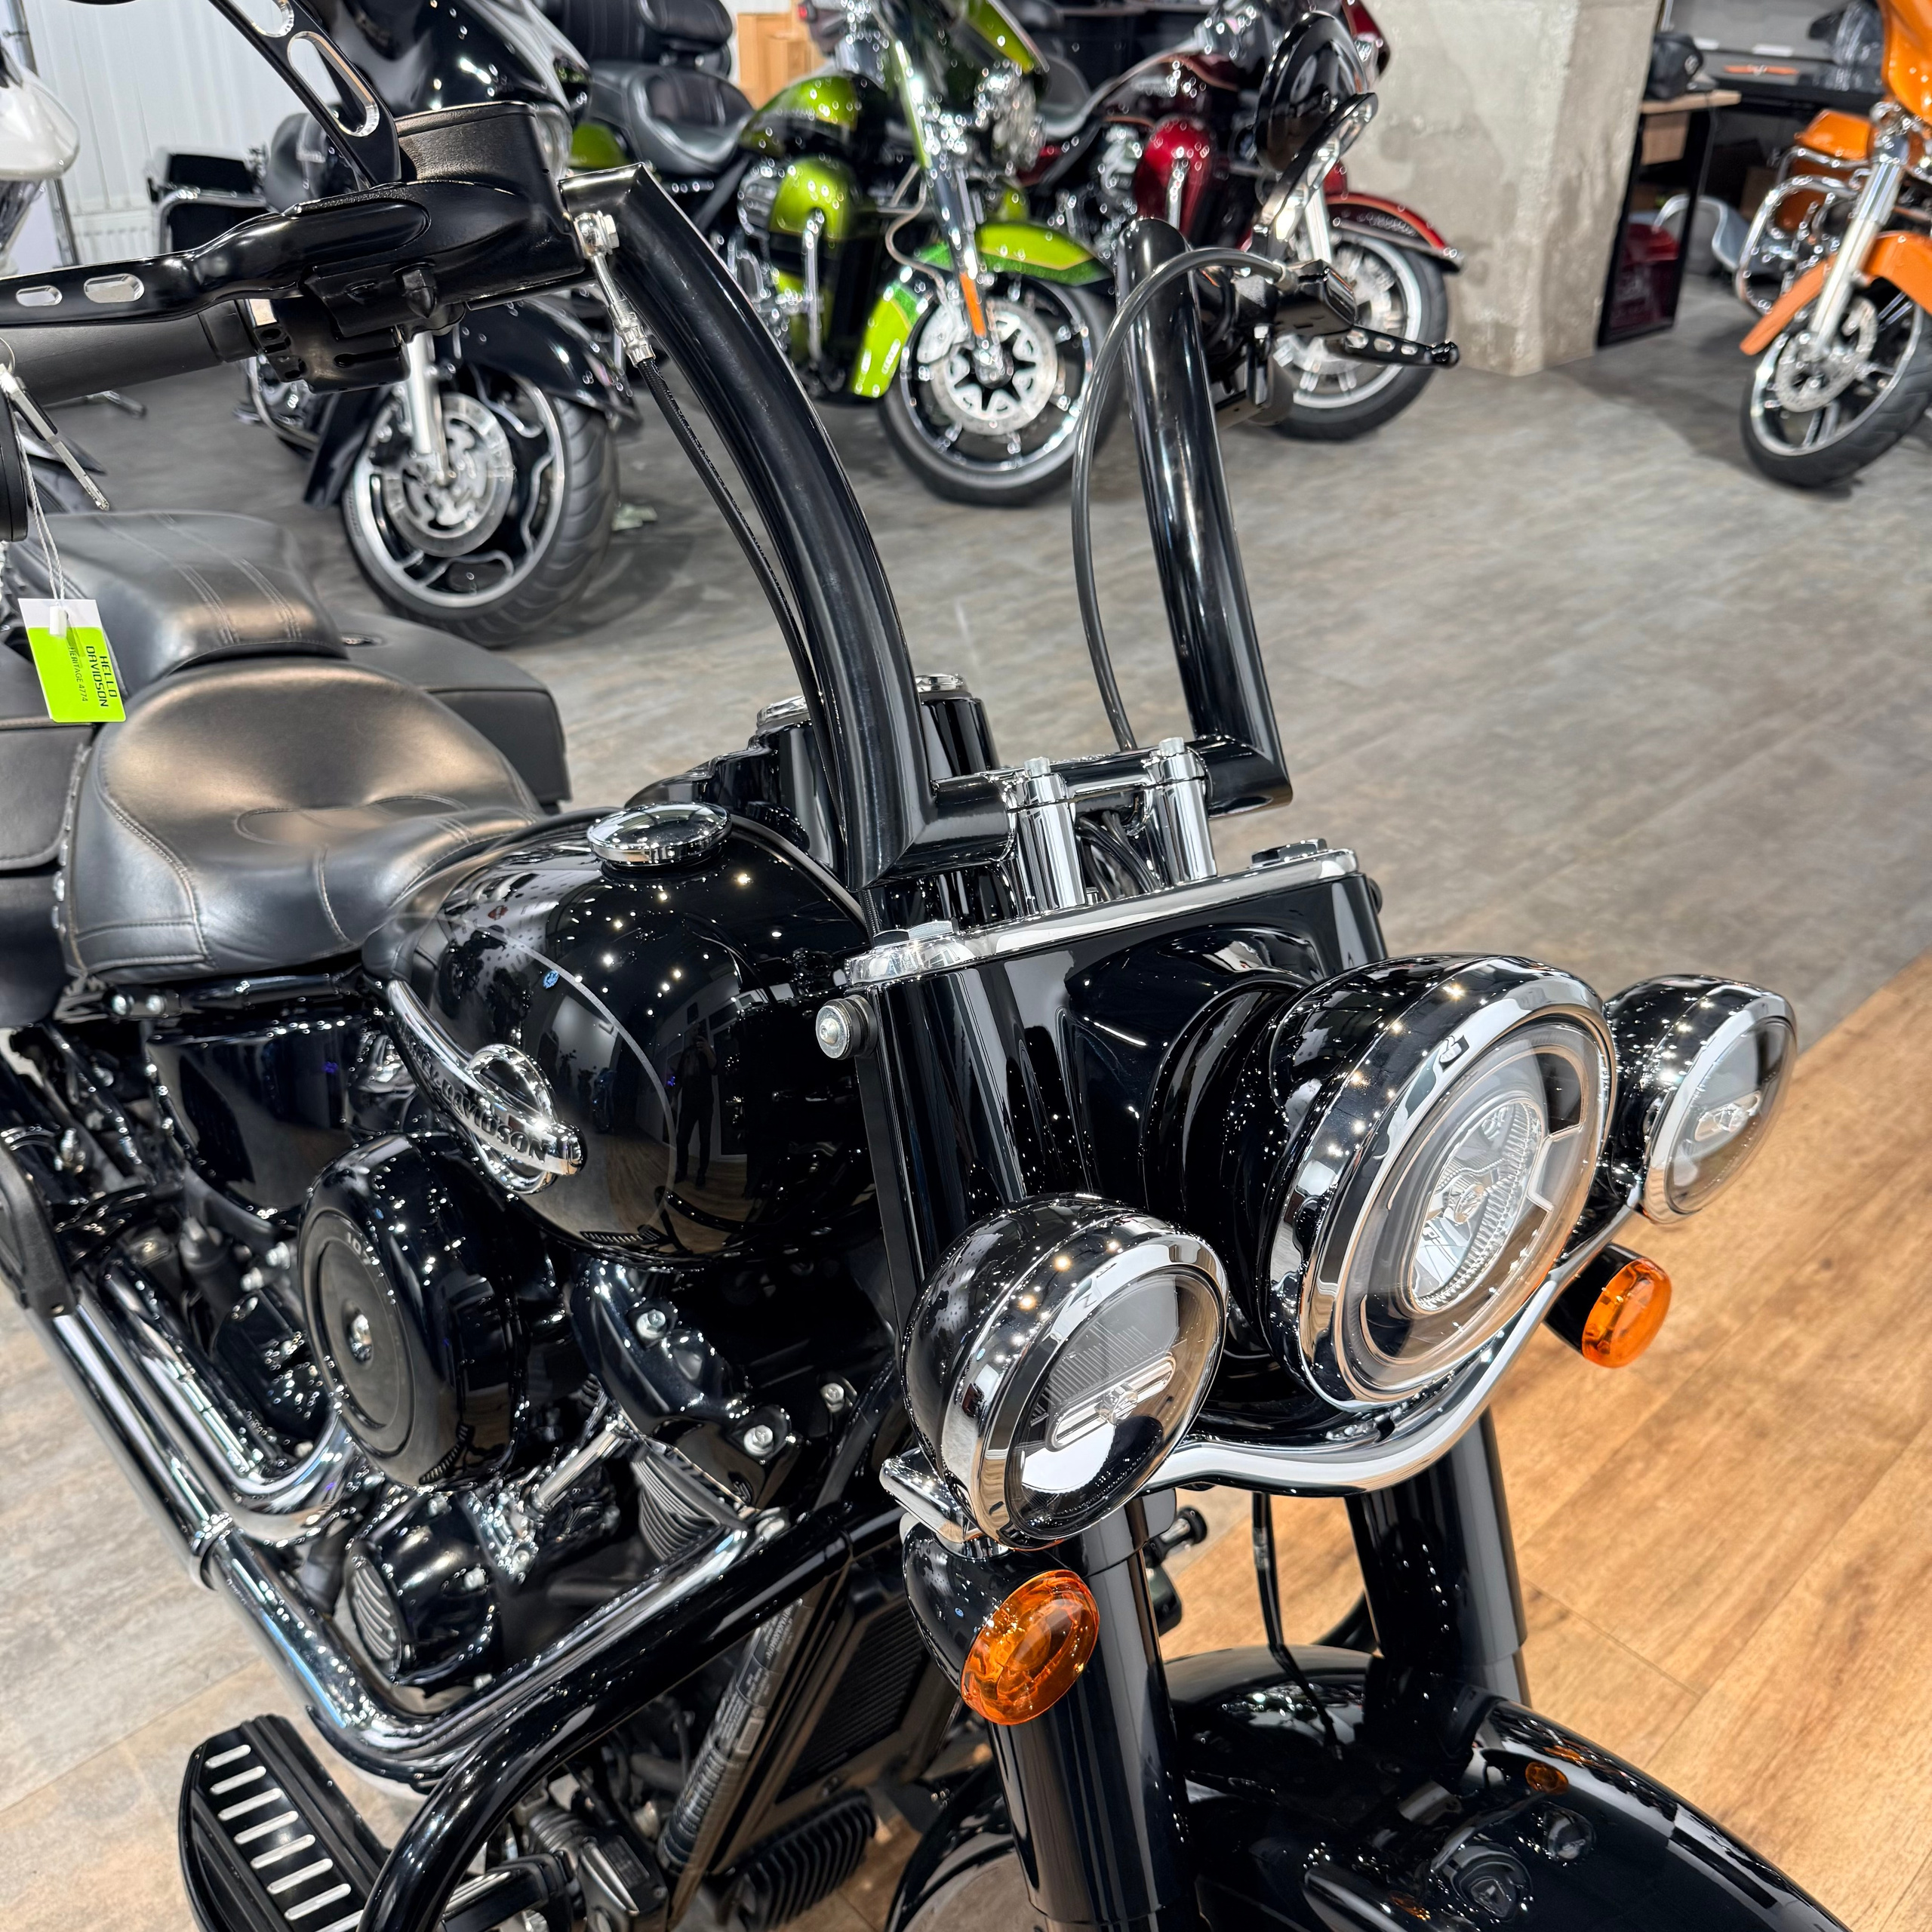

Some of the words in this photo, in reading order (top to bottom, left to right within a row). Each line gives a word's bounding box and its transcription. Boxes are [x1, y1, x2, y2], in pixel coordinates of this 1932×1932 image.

[69, 647, 84, 683] HERITAGE
[78, 684, 88, 702] 4774
[86, 645, 109, 707] DAVIDSON
[99, 656, 118, 697] HELLO
